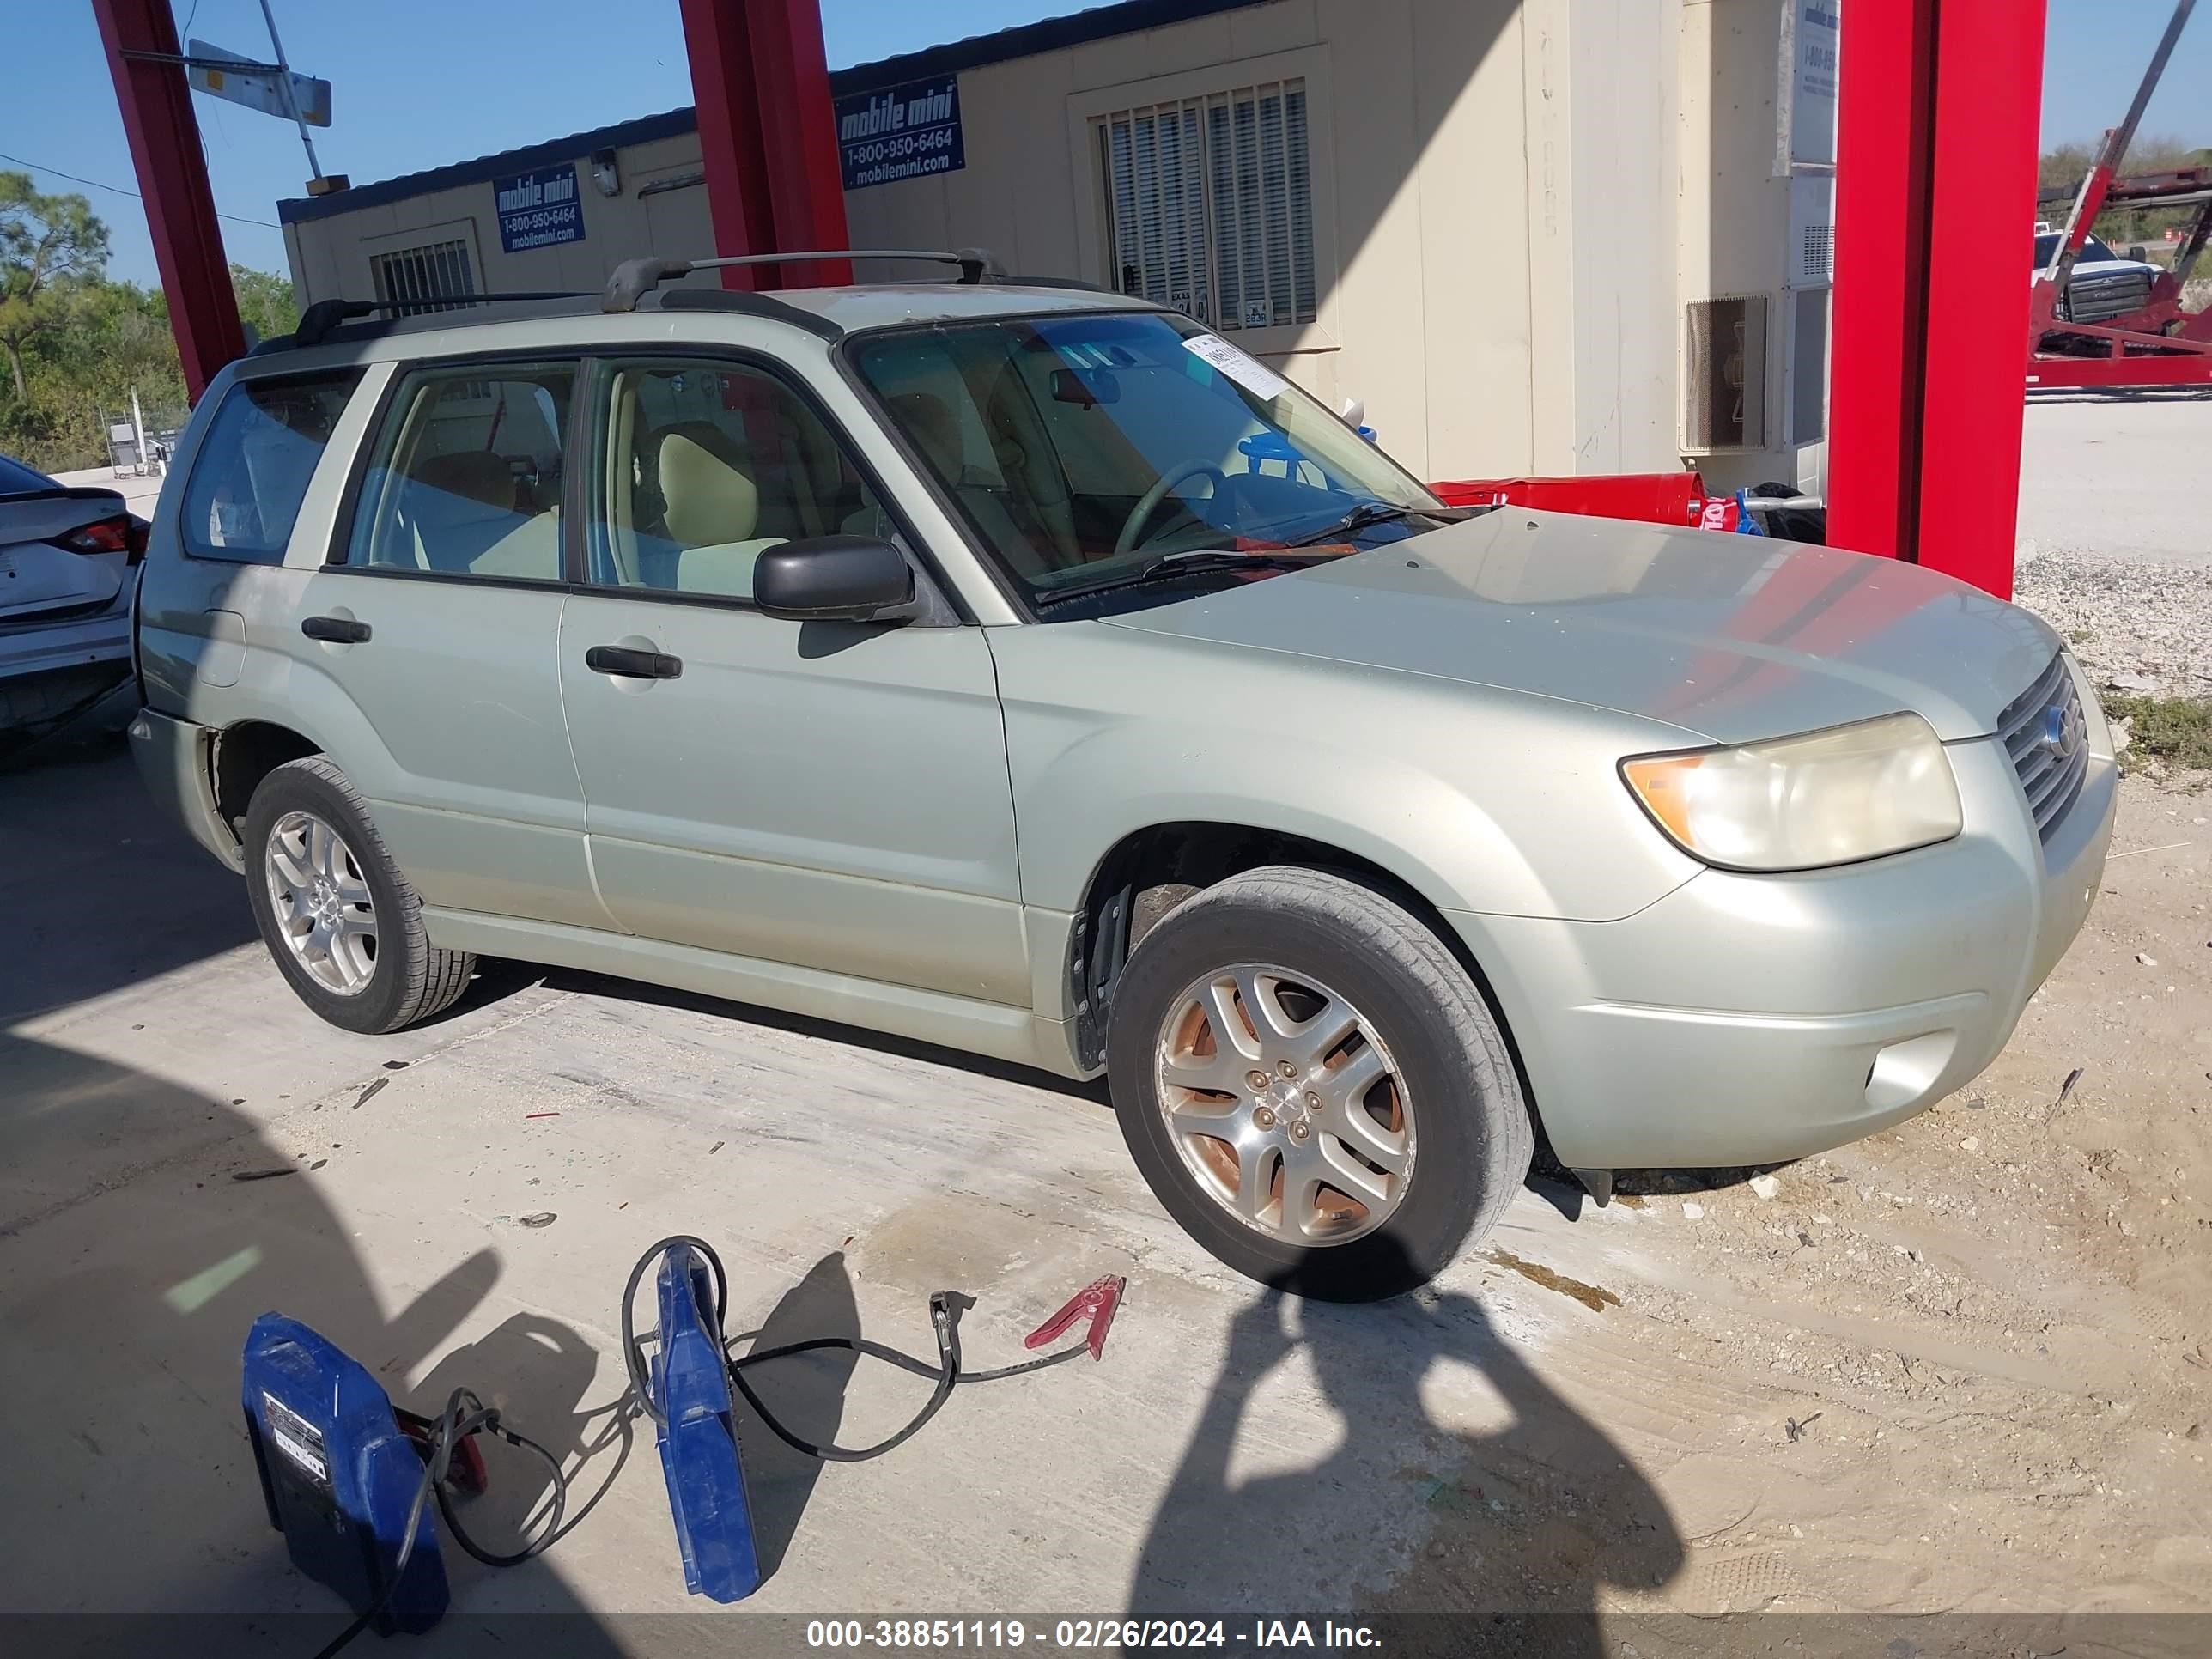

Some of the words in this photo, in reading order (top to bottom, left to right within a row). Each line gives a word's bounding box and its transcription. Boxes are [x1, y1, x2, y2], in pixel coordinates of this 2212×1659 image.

[841, 92, 905, 140] mobile
[907, 85, 953, 126] mini
[848, 128, 952, 166] 1-800-950-6464
[857, 155, 949, 185] mobilemini.com
[499, 174, 543, 212] mobile
[544, 172, 574, 204] mini
[504, 206, 575, 233] 1-800-950-6464
[512, 228, 574, 249] mobilemini.com
[1171, 292, 1190, 301] EXAS
